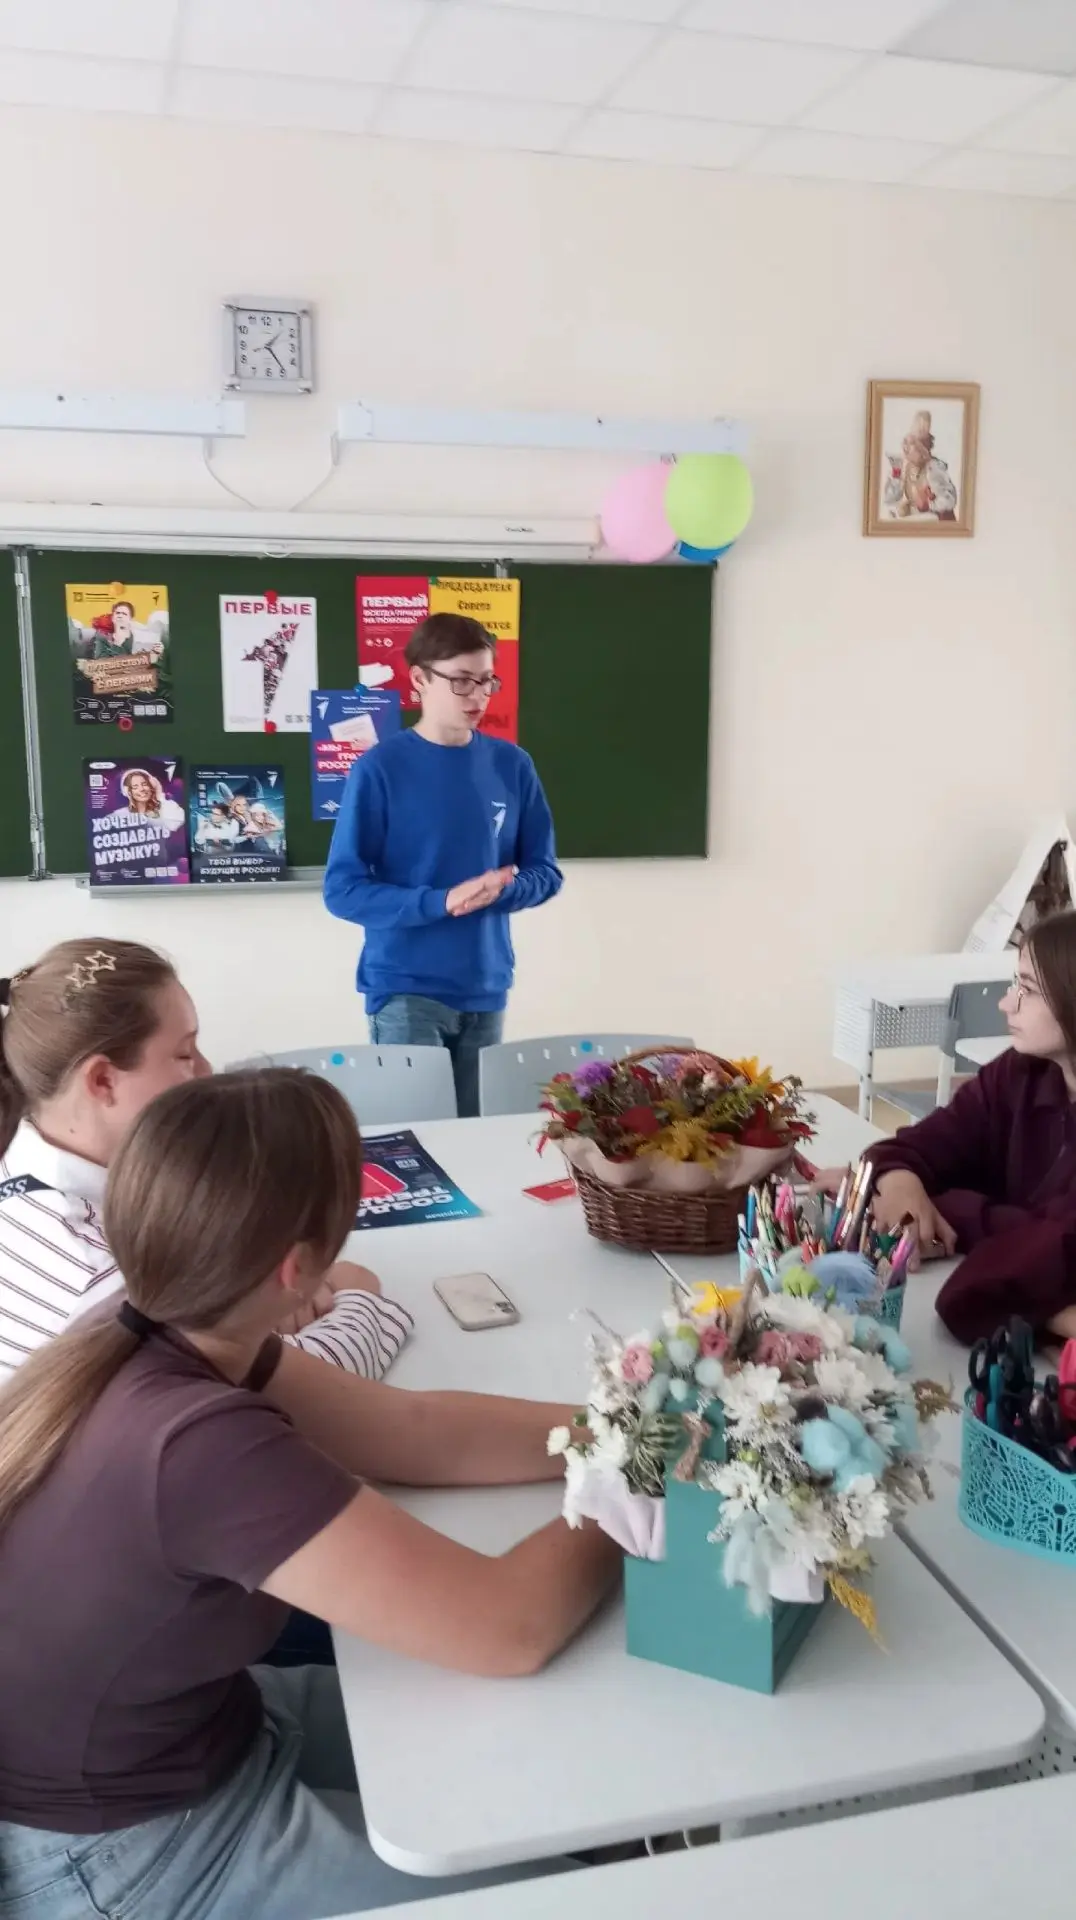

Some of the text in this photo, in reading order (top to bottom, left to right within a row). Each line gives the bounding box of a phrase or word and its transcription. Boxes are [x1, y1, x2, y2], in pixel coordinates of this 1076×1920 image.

[225, 601, 313, 615] ПЕРВЫЕ
[362, 593, 428, 607] ПЕРВЫЙ
[105, 674, 153, 687] ПЕРВЫМИ
[92, 813, 148, 833] ХОЧЕШЬ
[93, 827, 171, 849] СОЗДАВАТЬ
[94, 843, 160, 866] МУЗЫКУ?
